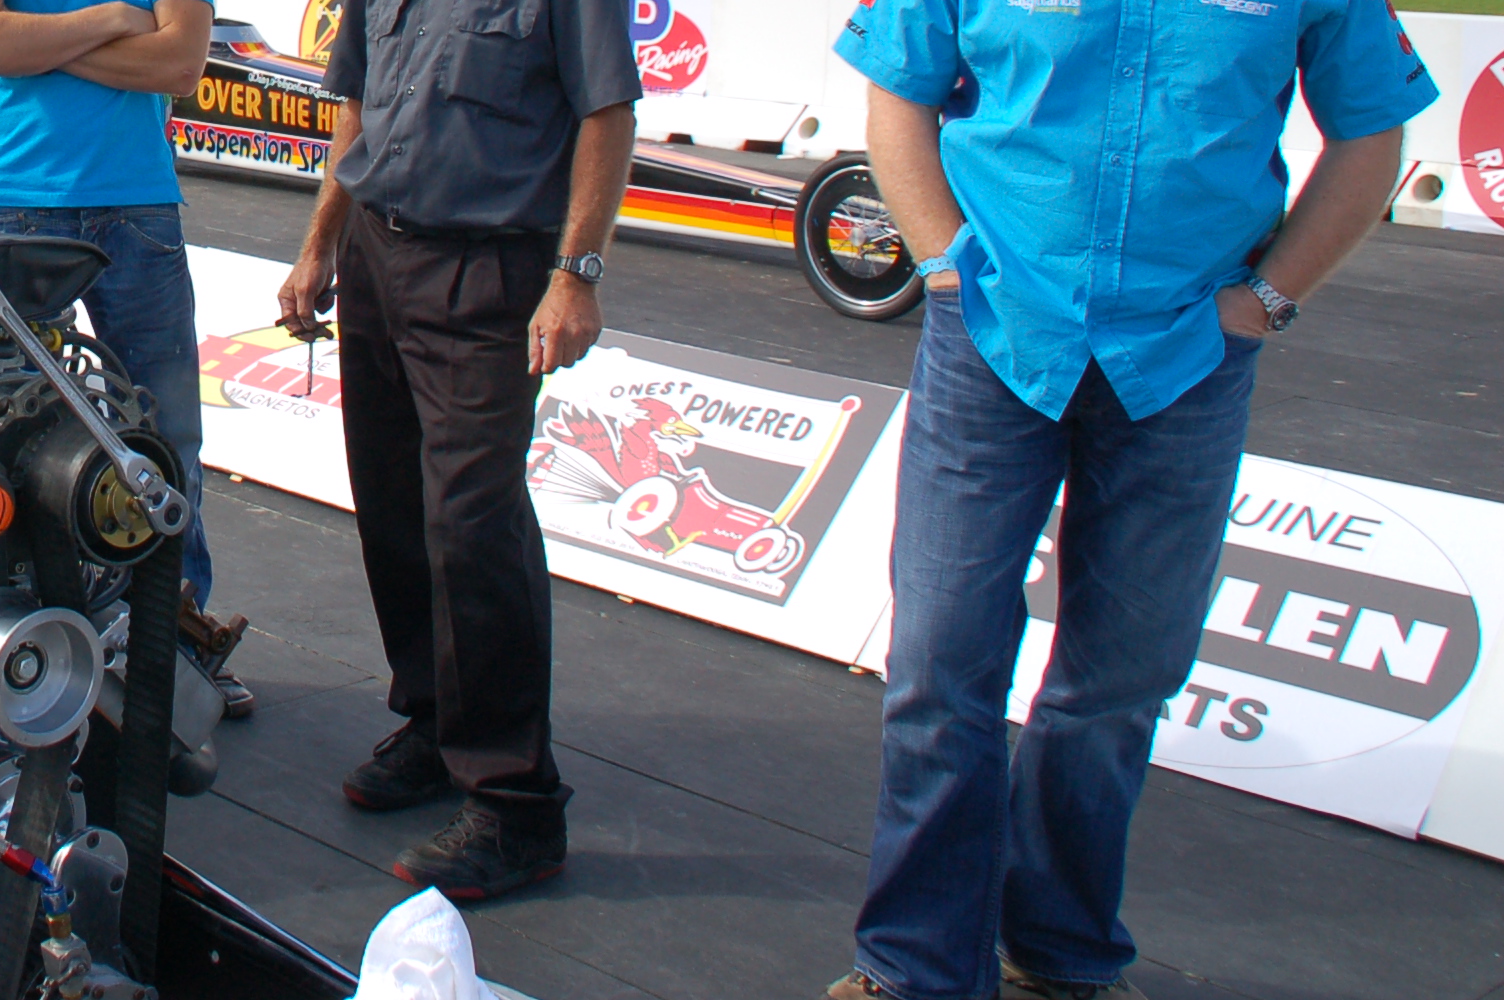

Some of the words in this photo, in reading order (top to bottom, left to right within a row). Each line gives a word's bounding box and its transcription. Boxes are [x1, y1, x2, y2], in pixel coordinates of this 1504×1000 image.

[639, 40, 710, 82] Racing
[196, 75, 262, 120] OVER
[268, 90, 310, 130] THE
[227, 387, 321, 419] MAGNETOS
[683, 394, 814, 442] POWERED
